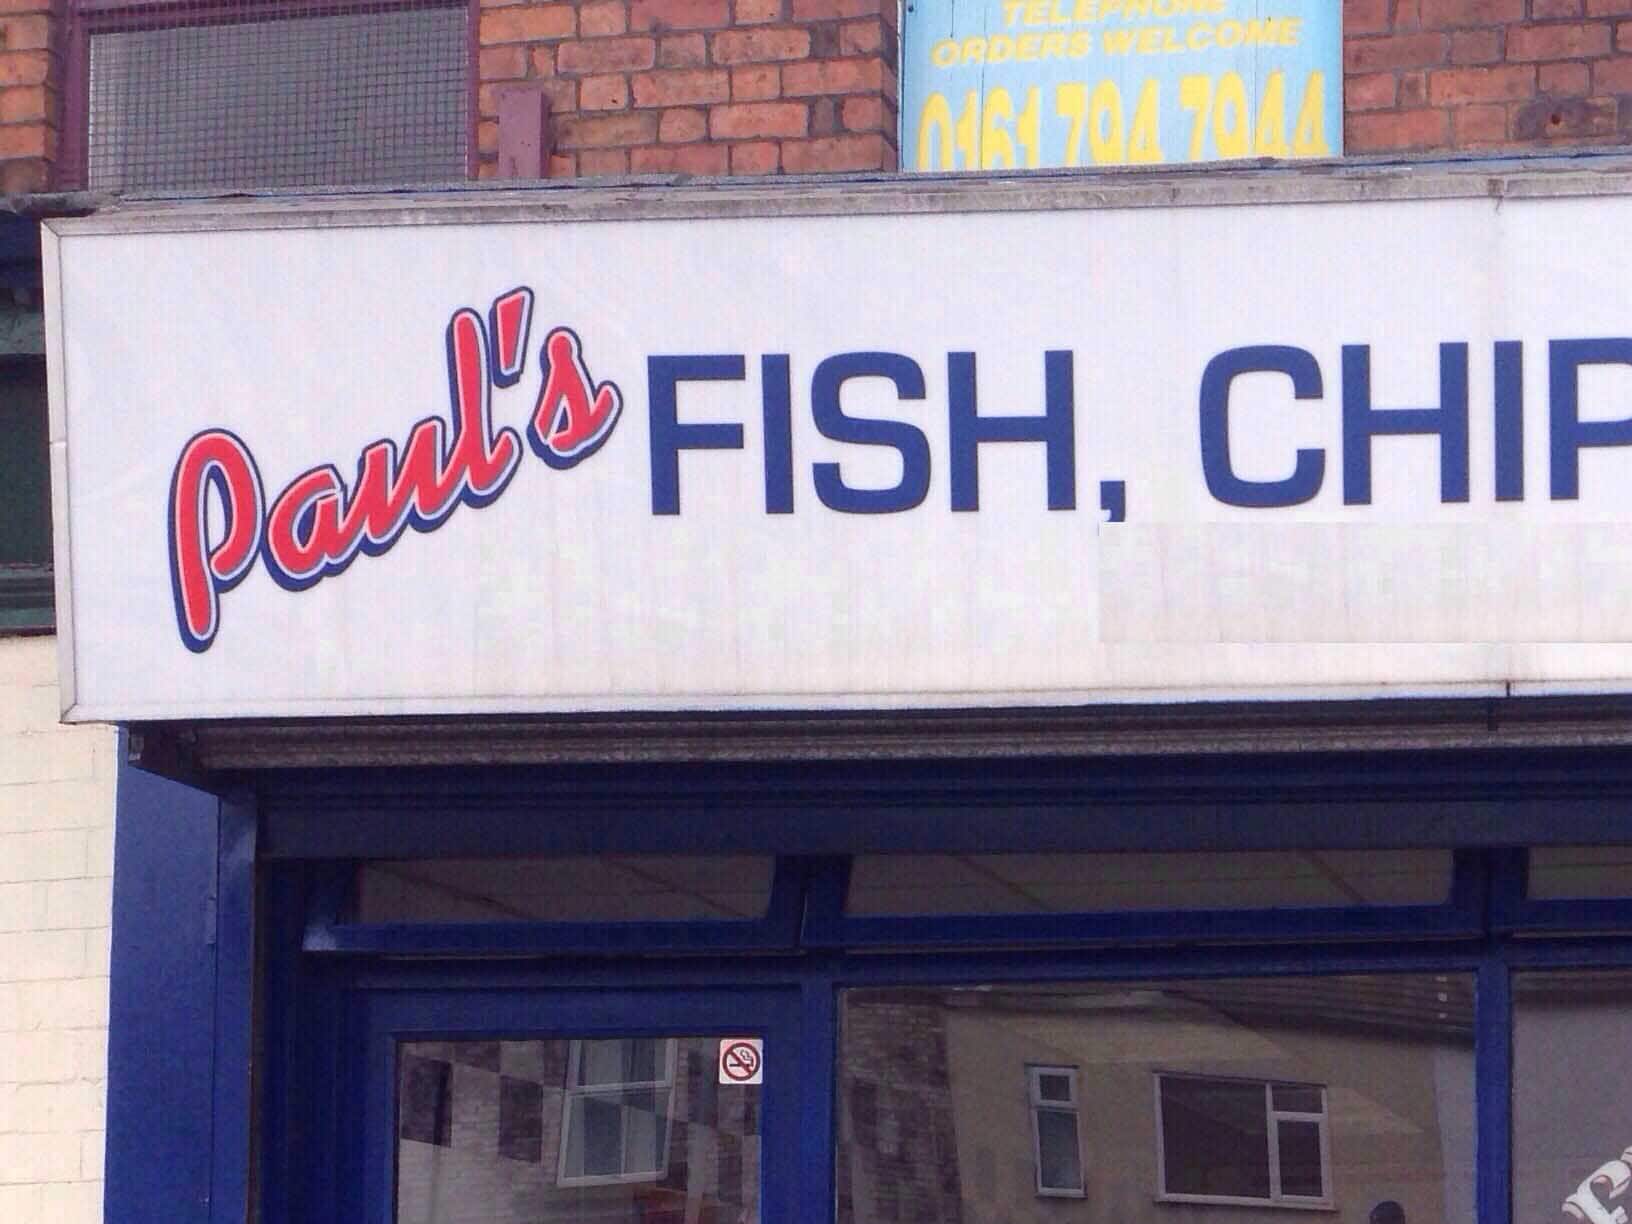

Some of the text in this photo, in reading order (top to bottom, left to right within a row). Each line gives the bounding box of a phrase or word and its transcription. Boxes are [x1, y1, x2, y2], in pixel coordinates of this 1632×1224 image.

[931, 17, 1304, 68] ORDERS WELCOME
[918, 85, 1041, 171] 0161
[168, 286, 623, 654] Paul's
[646, 350, 1126, 522] FISH,
